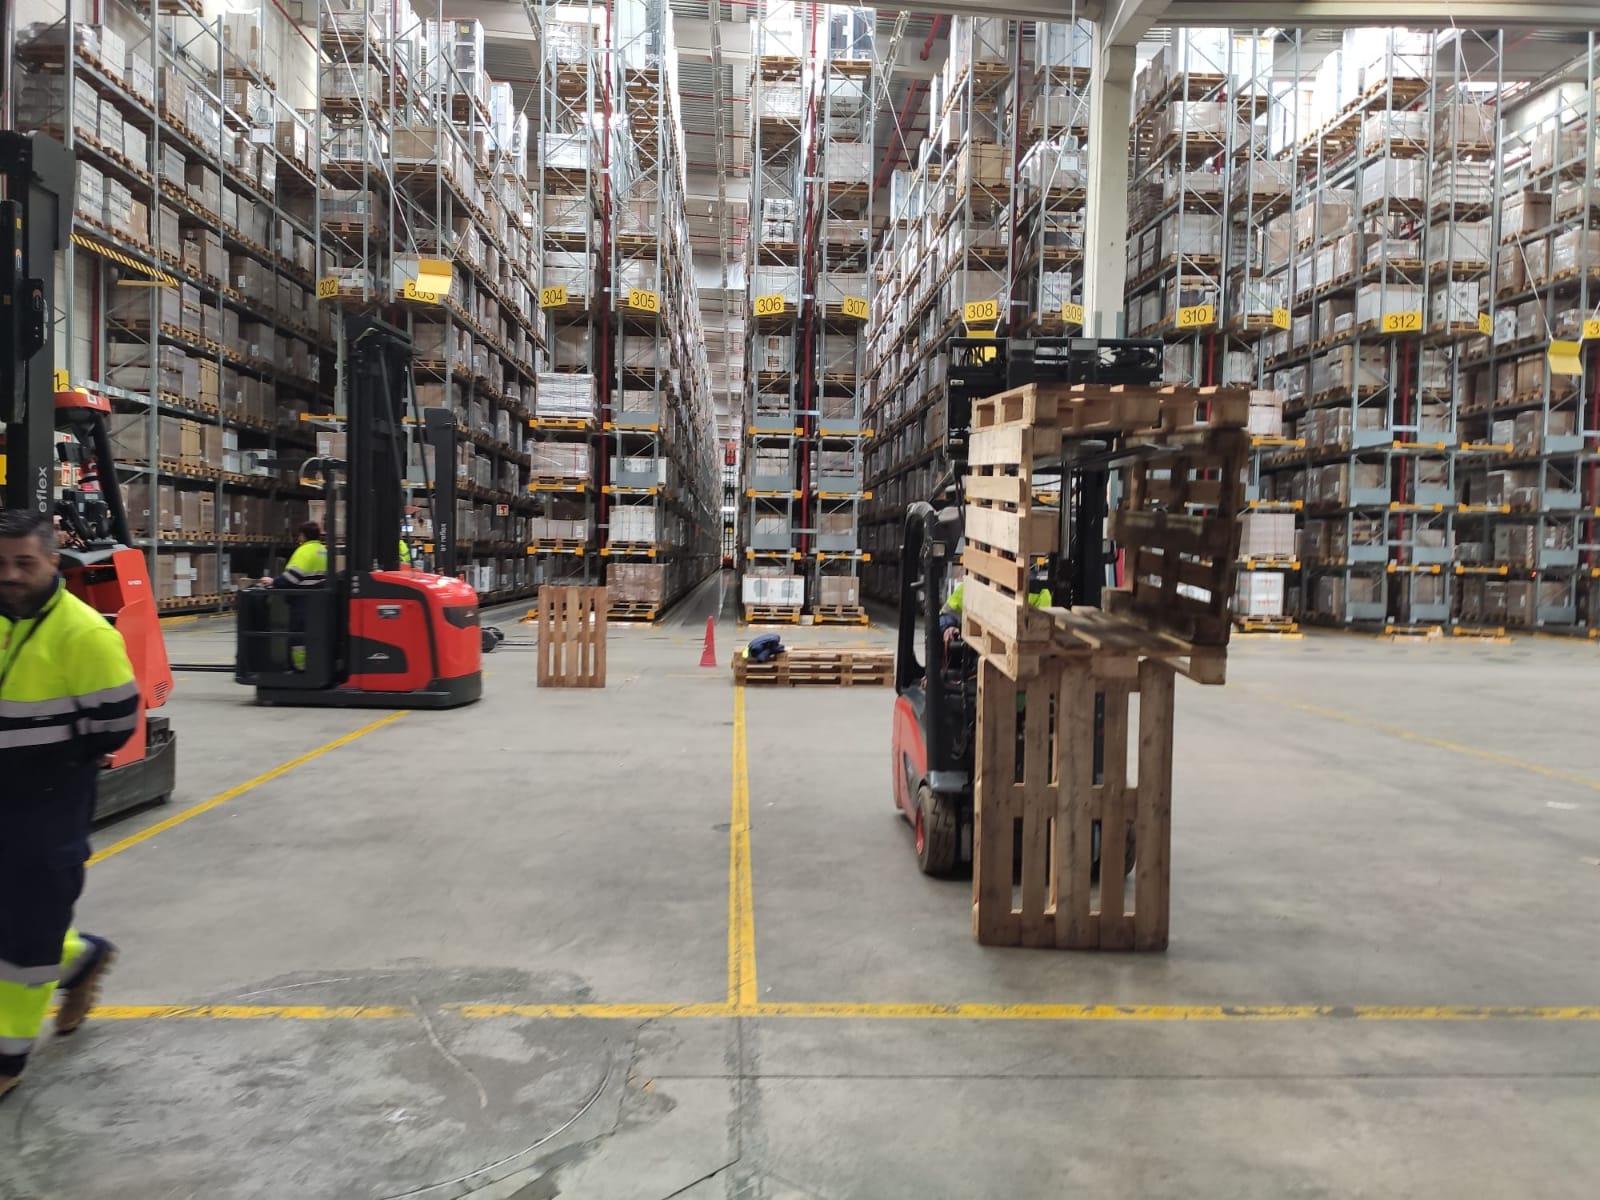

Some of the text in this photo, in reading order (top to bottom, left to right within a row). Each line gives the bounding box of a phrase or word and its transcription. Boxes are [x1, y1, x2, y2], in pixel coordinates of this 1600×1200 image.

[319, 279, 335, 297] 302
[543, 289, 562, 305] 304
[632, 291, 655, 309] 305
[758, 297, 781, 313] 306
[847, 298, 866, 315] 307
[967, 303, 993, 319] 308
[1065, 304, 1082, 321] 309
[1182, 307, 1207, 324] 310
[1278, 310, 1287, 326] 311
[1389, 313, 1415, 329] 312
[36, 466, 48, 513] eflex
